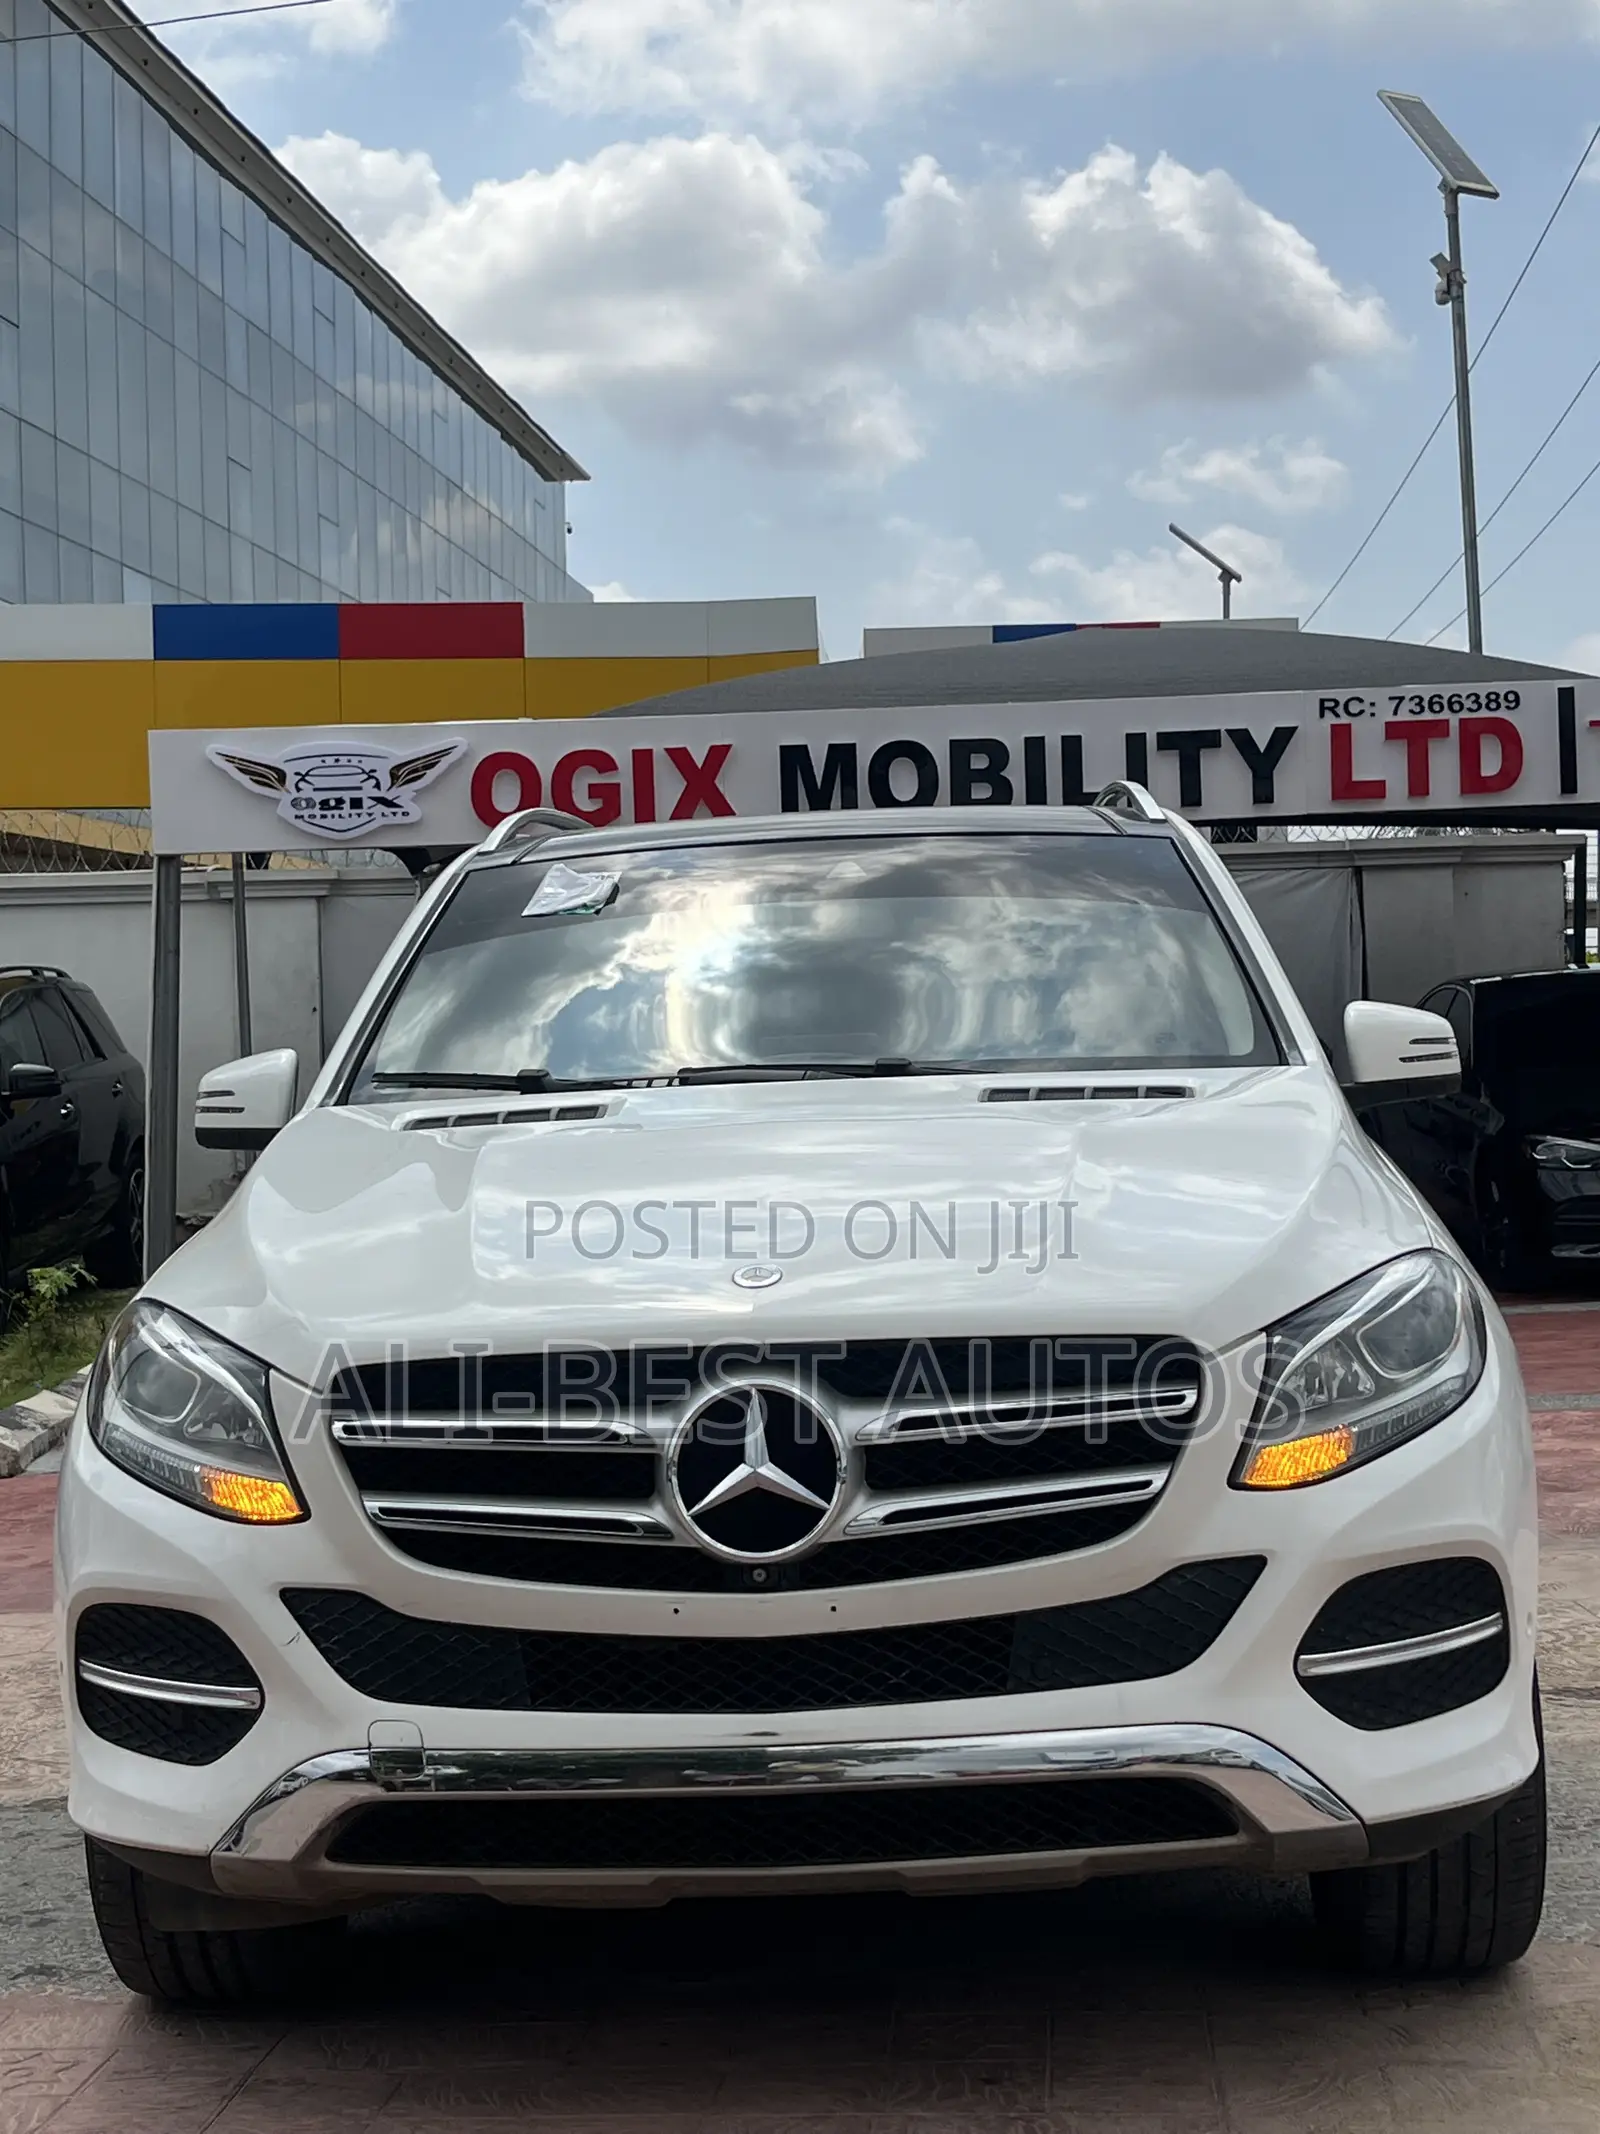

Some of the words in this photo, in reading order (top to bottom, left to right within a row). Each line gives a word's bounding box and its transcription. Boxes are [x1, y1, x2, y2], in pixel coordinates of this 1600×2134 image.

[1319, 696, 1376, 718] RC:
[1388, 690, 1521, 716] 7366389
[470, 744, 737, 831] OGIX
[779, 725, 1299, 813] MOBILITY
[1330, 716, 1524, 801] LTD
[294, 812, 374, 820] MOBILITY
